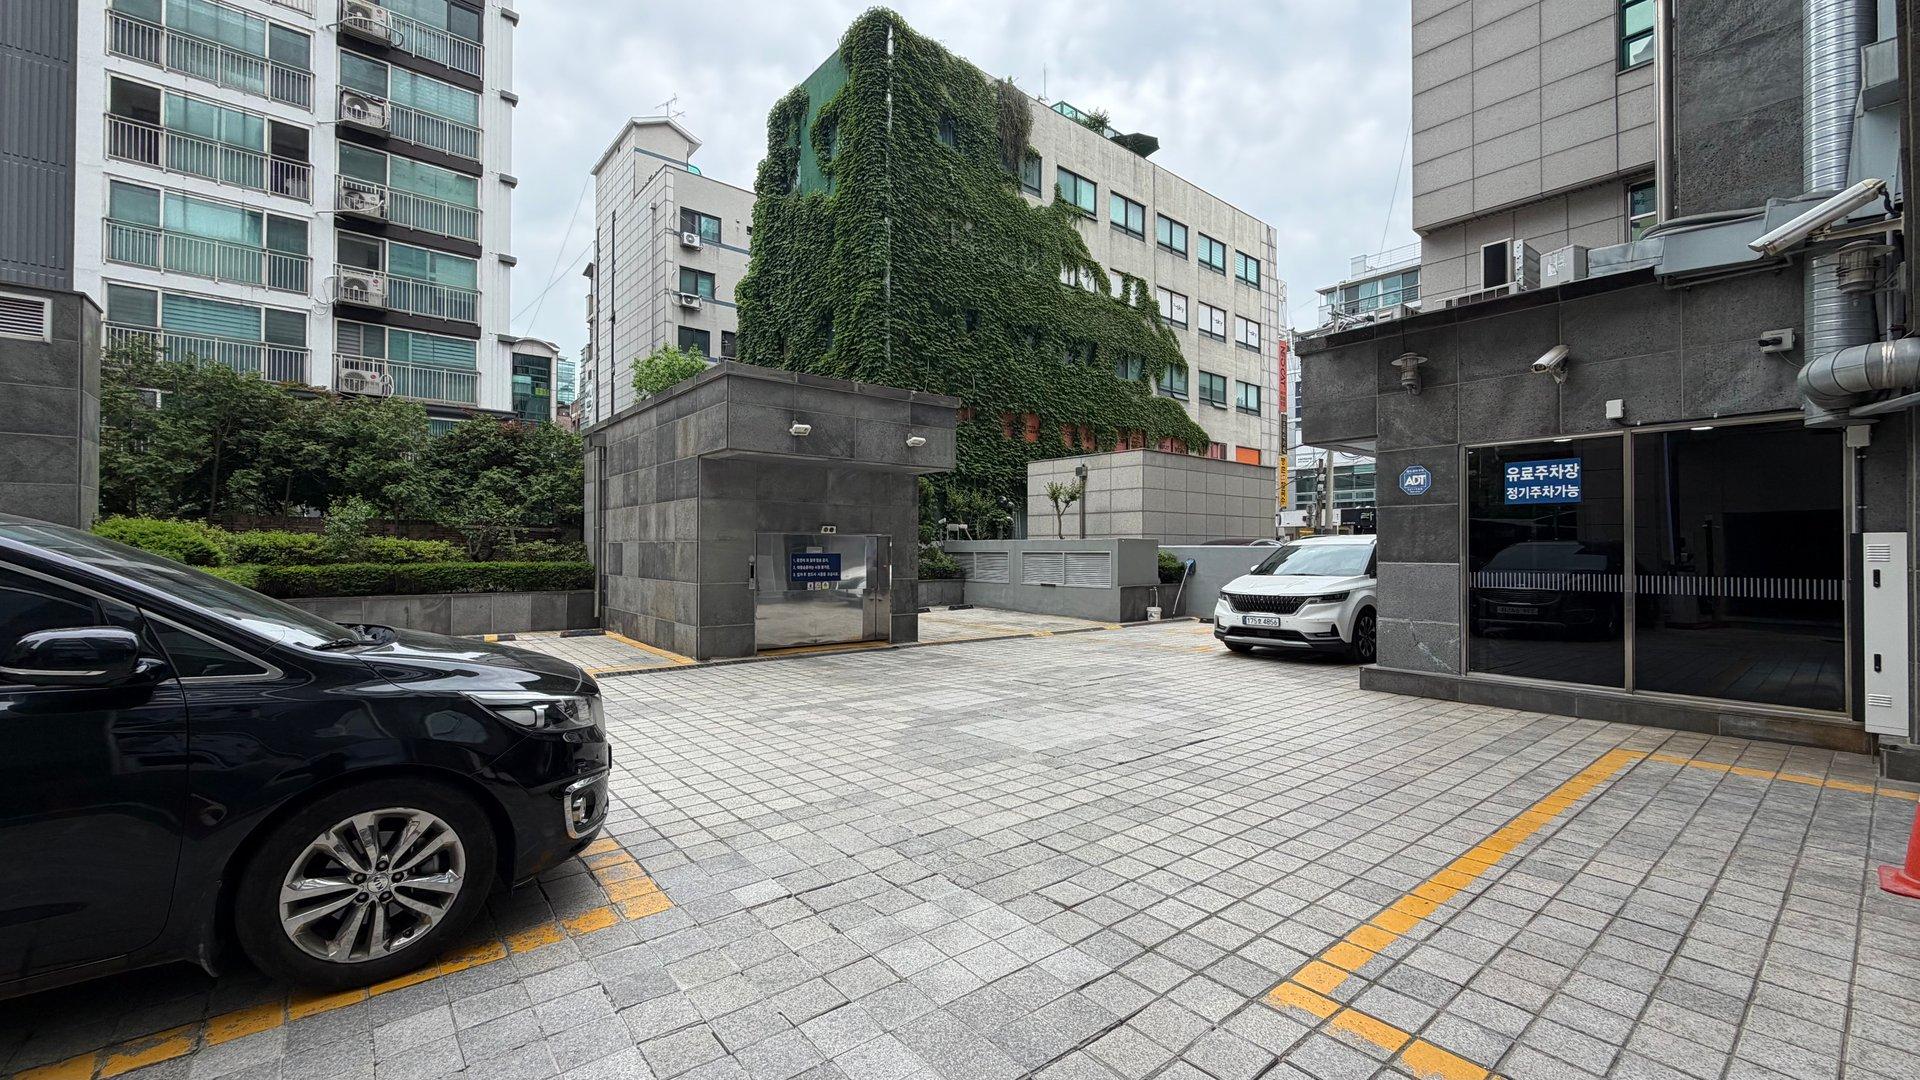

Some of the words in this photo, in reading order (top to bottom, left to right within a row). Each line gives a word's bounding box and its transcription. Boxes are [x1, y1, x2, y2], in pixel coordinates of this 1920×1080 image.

[1507, 463, 1580, 482] 유료주차장
[1404, 475, 1425, 486] ADT
[1507, 485, 1580, 500] 정기주차가능
